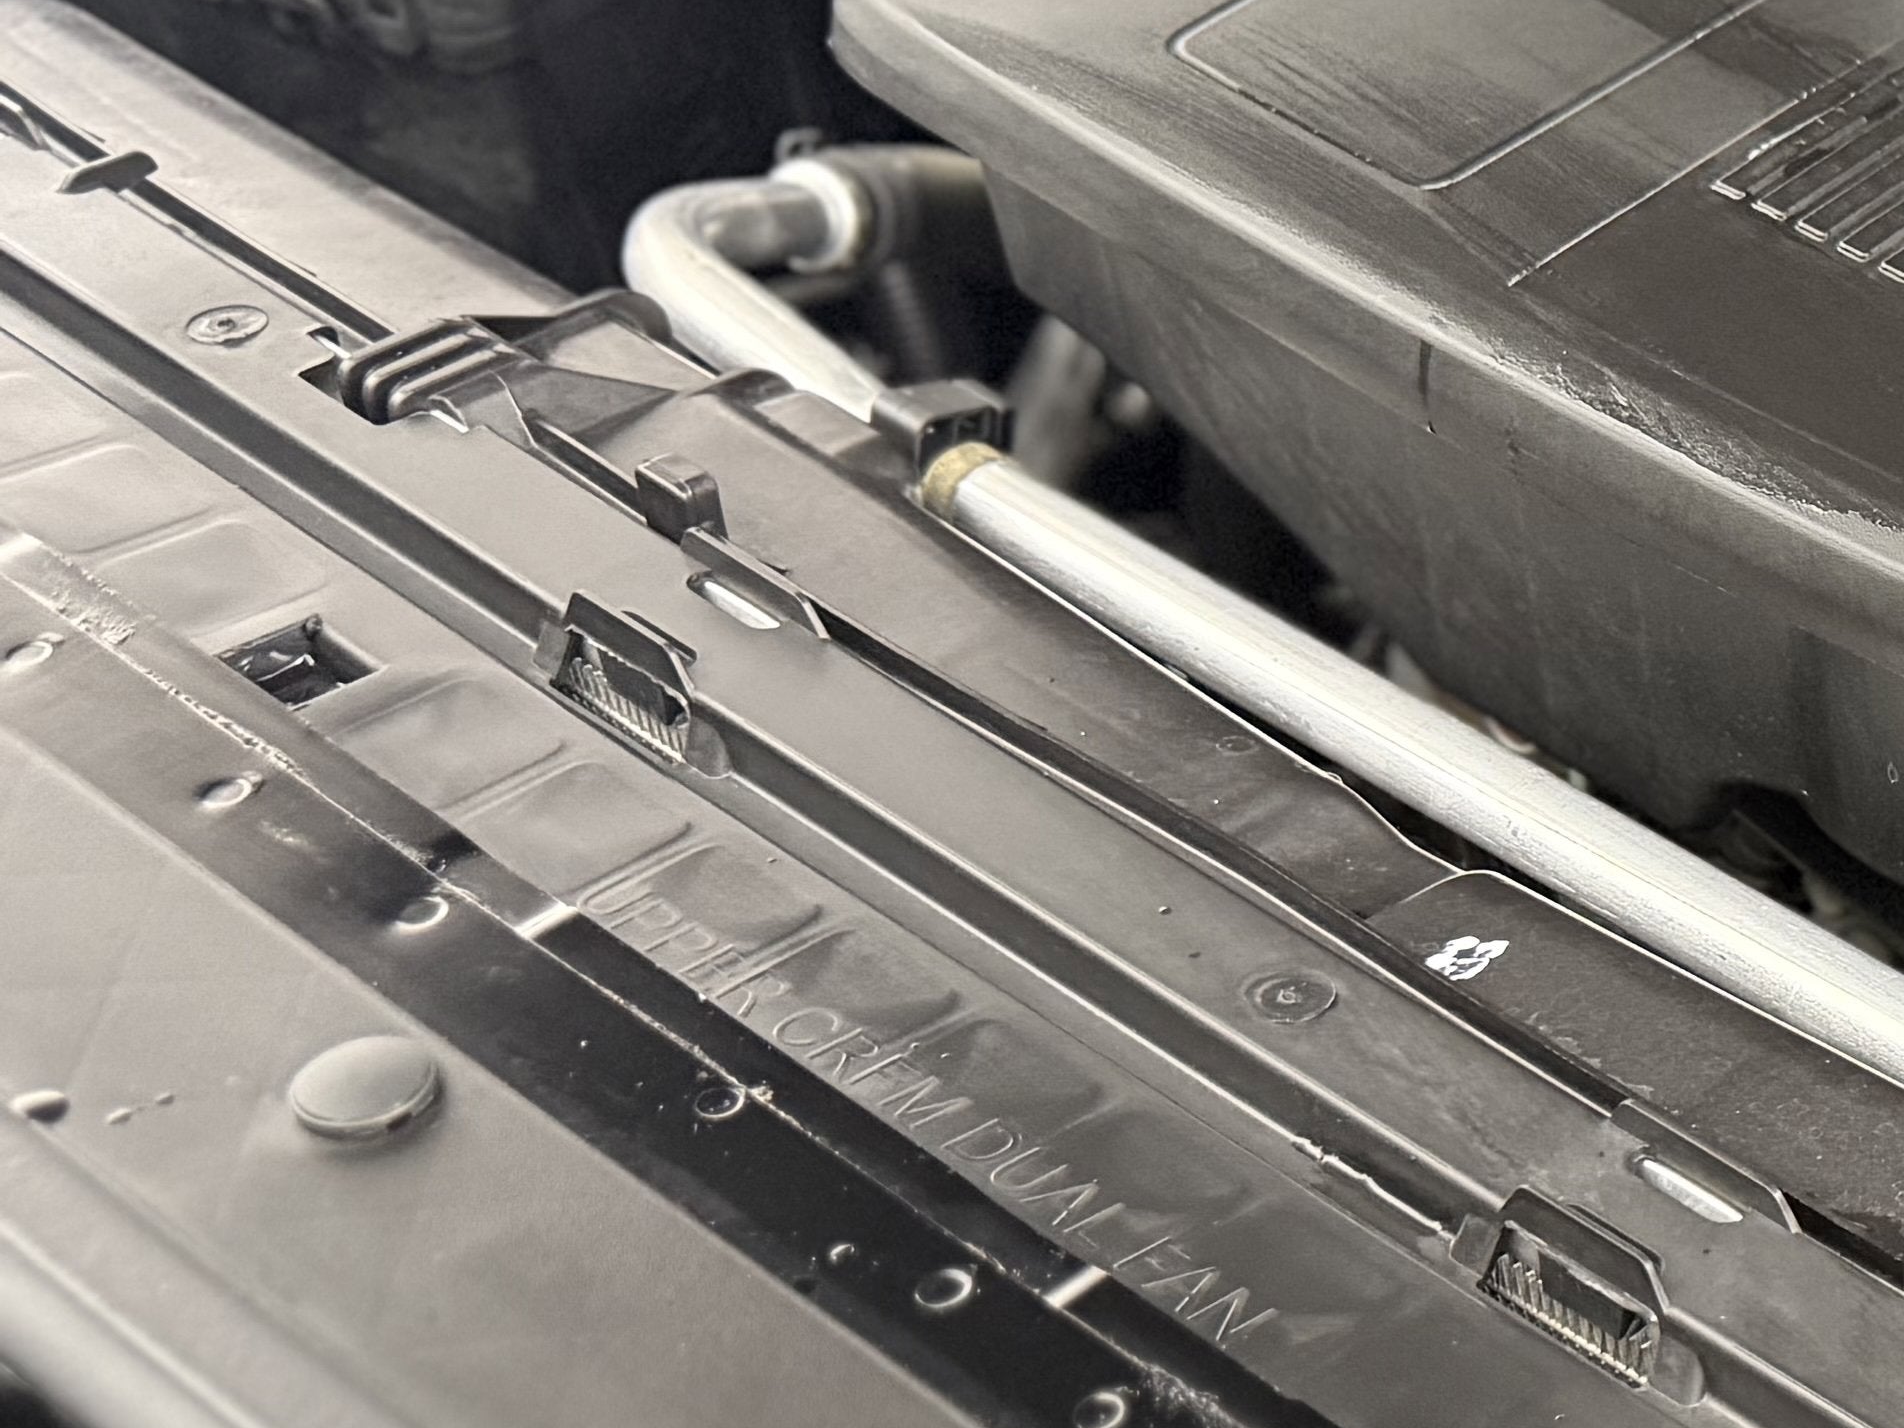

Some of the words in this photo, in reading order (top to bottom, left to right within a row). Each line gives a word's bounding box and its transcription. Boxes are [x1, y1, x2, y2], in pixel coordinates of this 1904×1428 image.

[774, 1006, 970, 1131] CRFM
[941, 1117, 1122, 1239] DUAL
[1112, 1236, 1278, 1344] FAN
